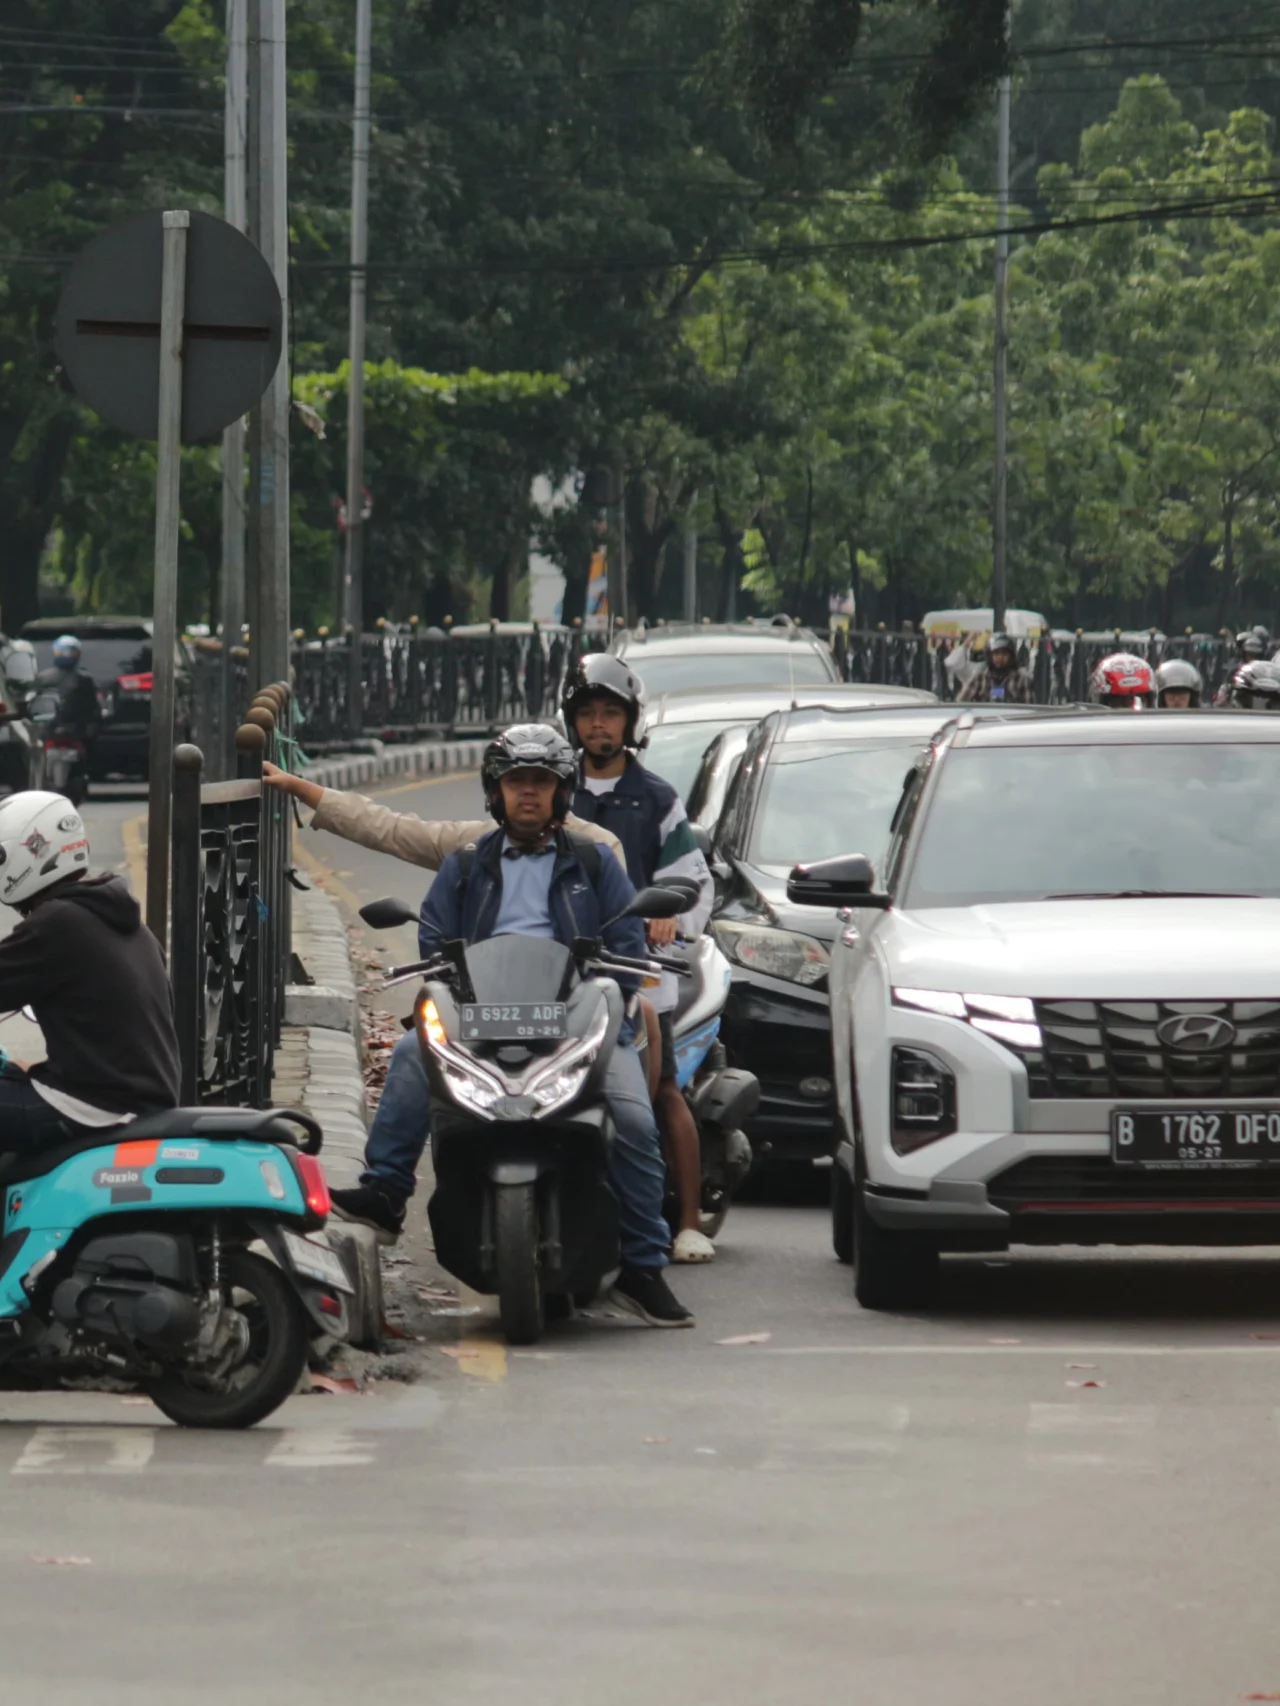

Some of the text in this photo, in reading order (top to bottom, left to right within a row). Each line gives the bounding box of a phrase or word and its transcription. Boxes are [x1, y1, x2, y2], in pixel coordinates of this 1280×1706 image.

[465, 1005, 562, 1022] D 6922 ADF
[1118, 1115, 1135, 1146] B
[1161, 1114, 1222, 1145] 1762
